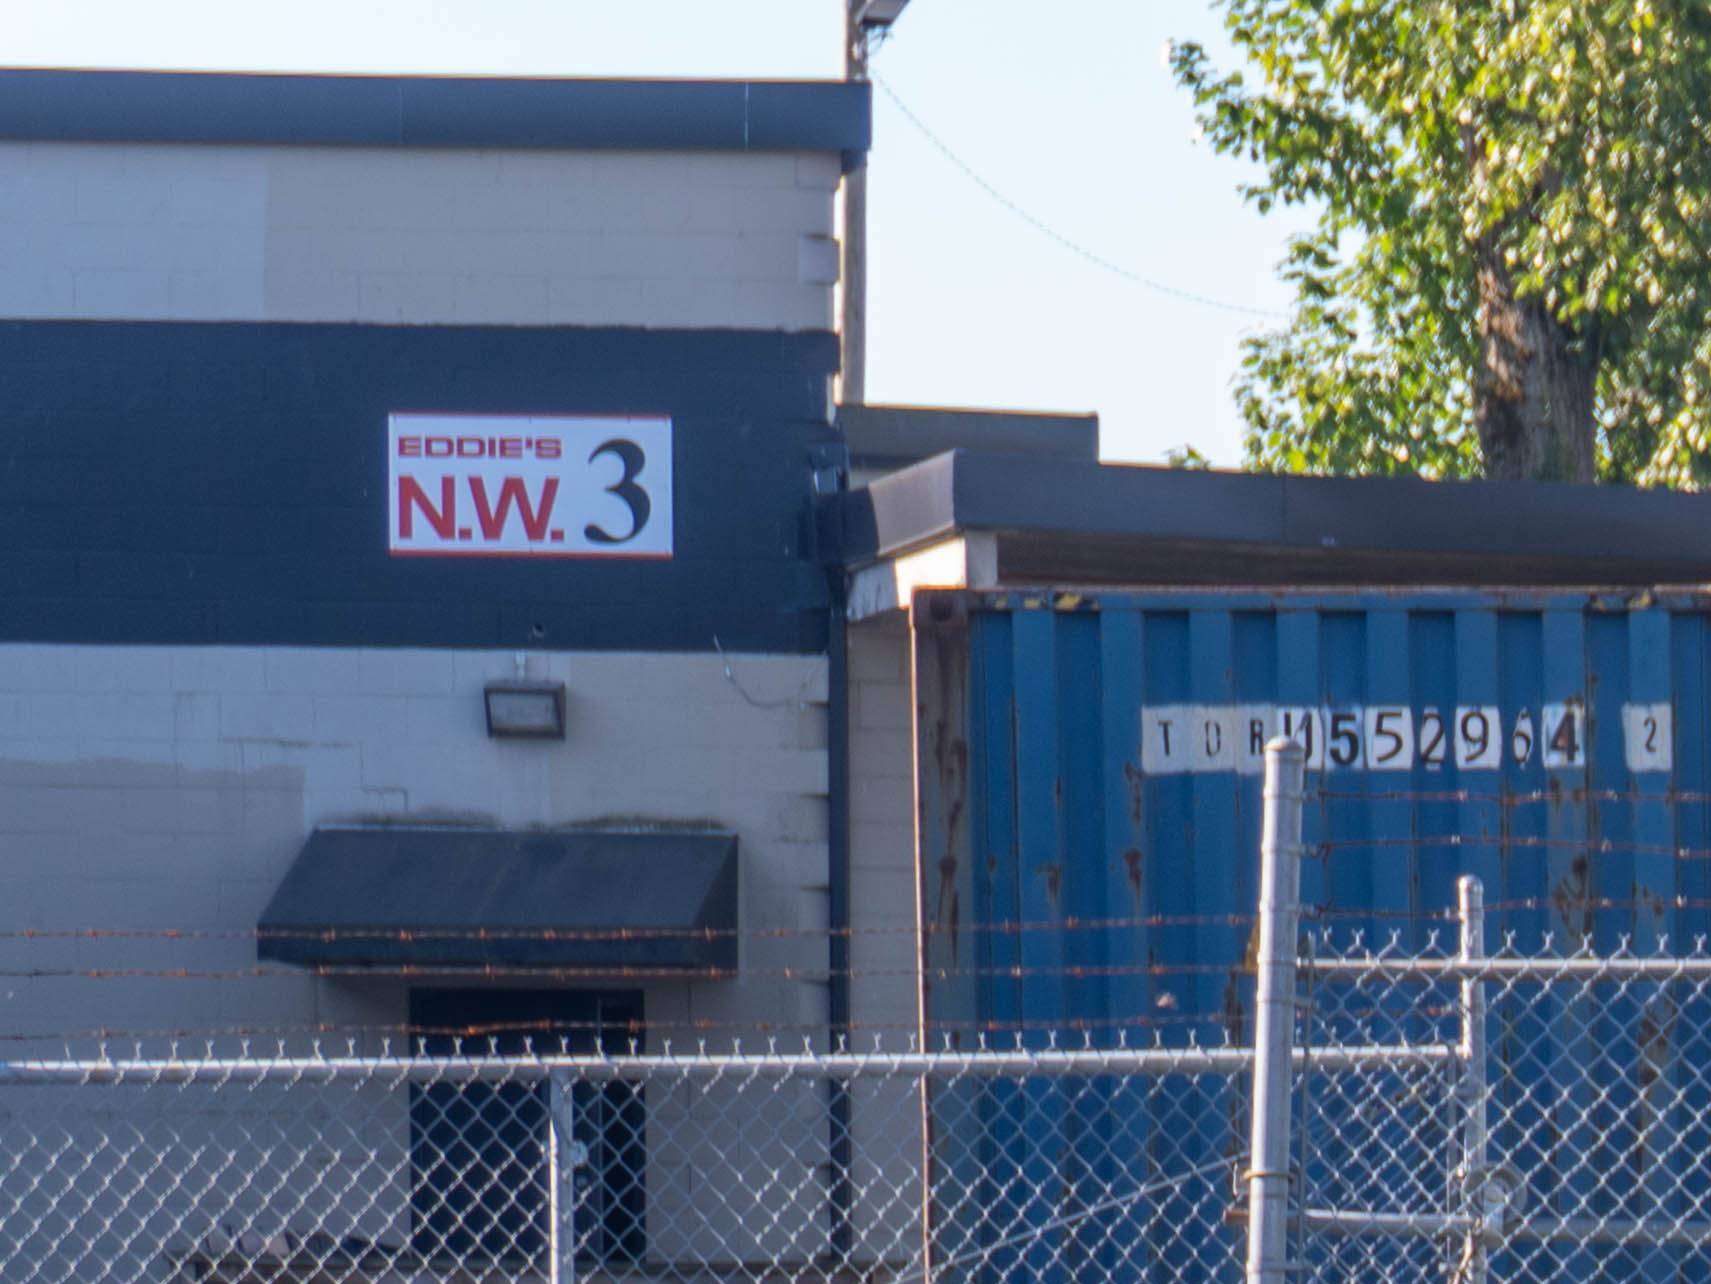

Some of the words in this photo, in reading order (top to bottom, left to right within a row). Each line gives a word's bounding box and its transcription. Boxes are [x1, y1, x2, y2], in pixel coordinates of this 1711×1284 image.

[398, 436, 562, 459] EDDIE'S
[398, 475, 565, 542] N.W.
[583, 438, 651, 544] 3
